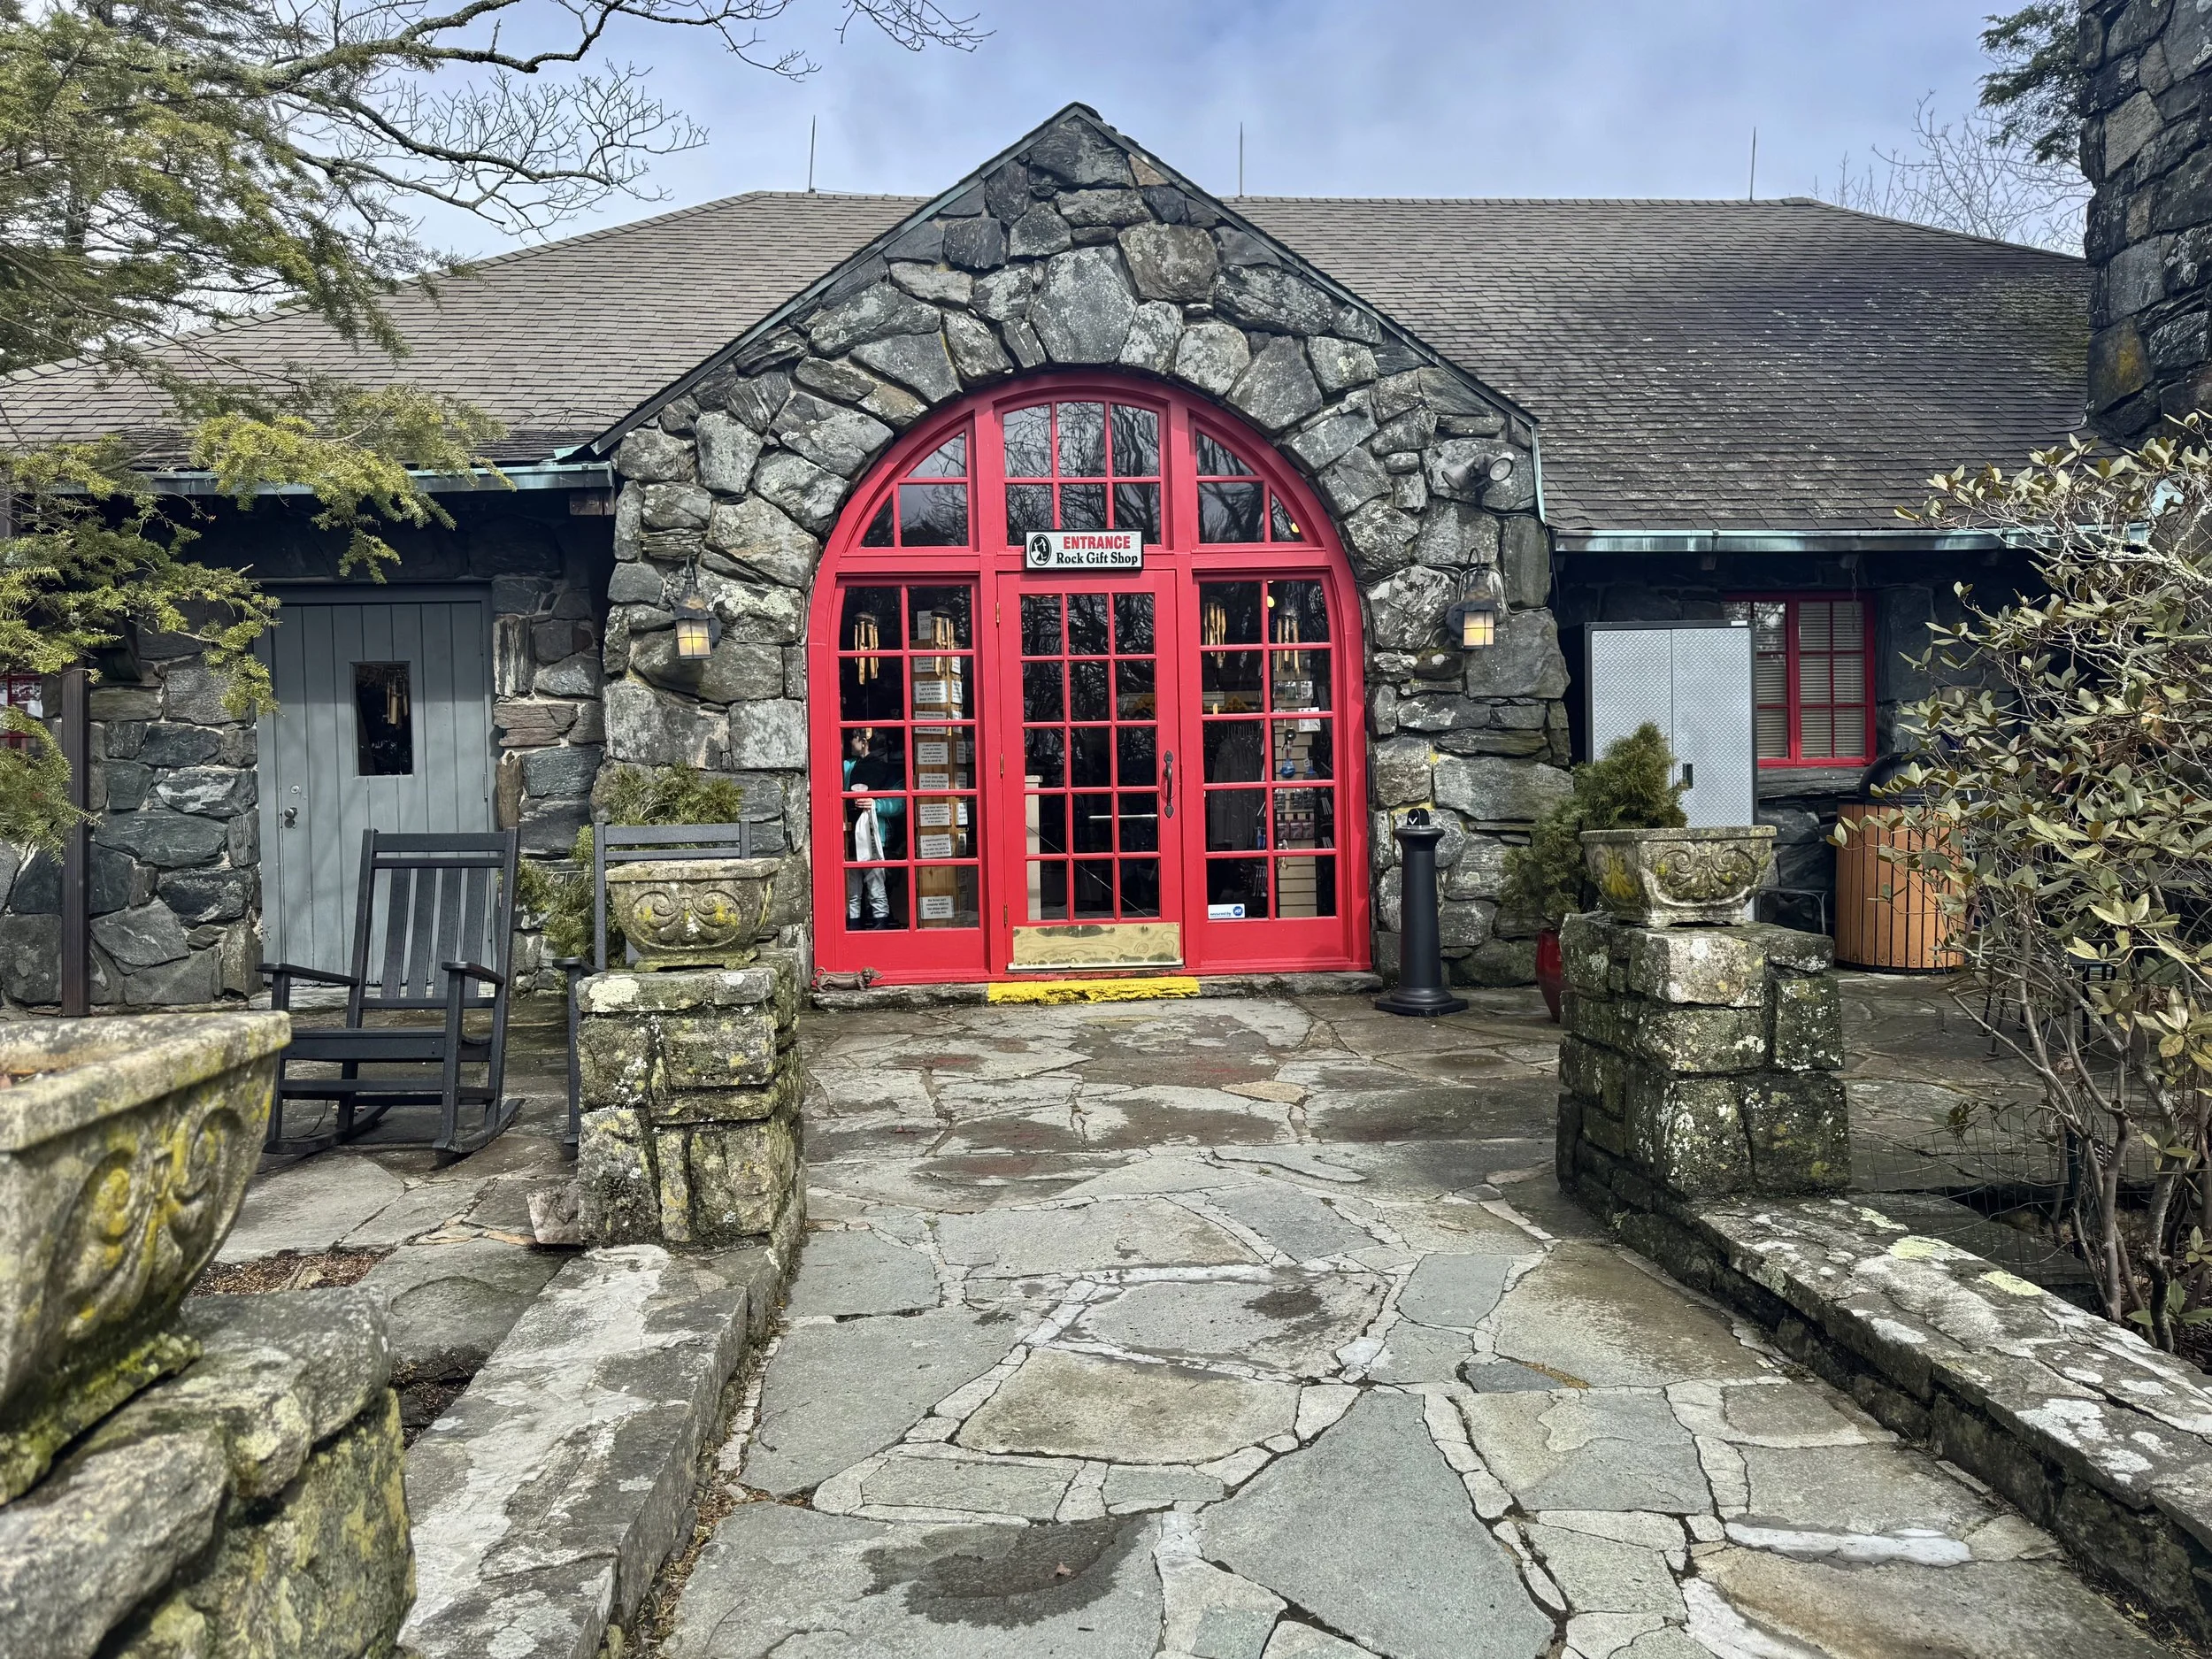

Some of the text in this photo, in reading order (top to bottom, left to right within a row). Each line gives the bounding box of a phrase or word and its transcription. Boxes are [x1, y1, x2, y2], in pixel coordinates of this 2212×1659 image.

[1064, 535, 1131, 549] ENTRANCE
[1056, 551, 1138, 565] Rock Gift Shop
